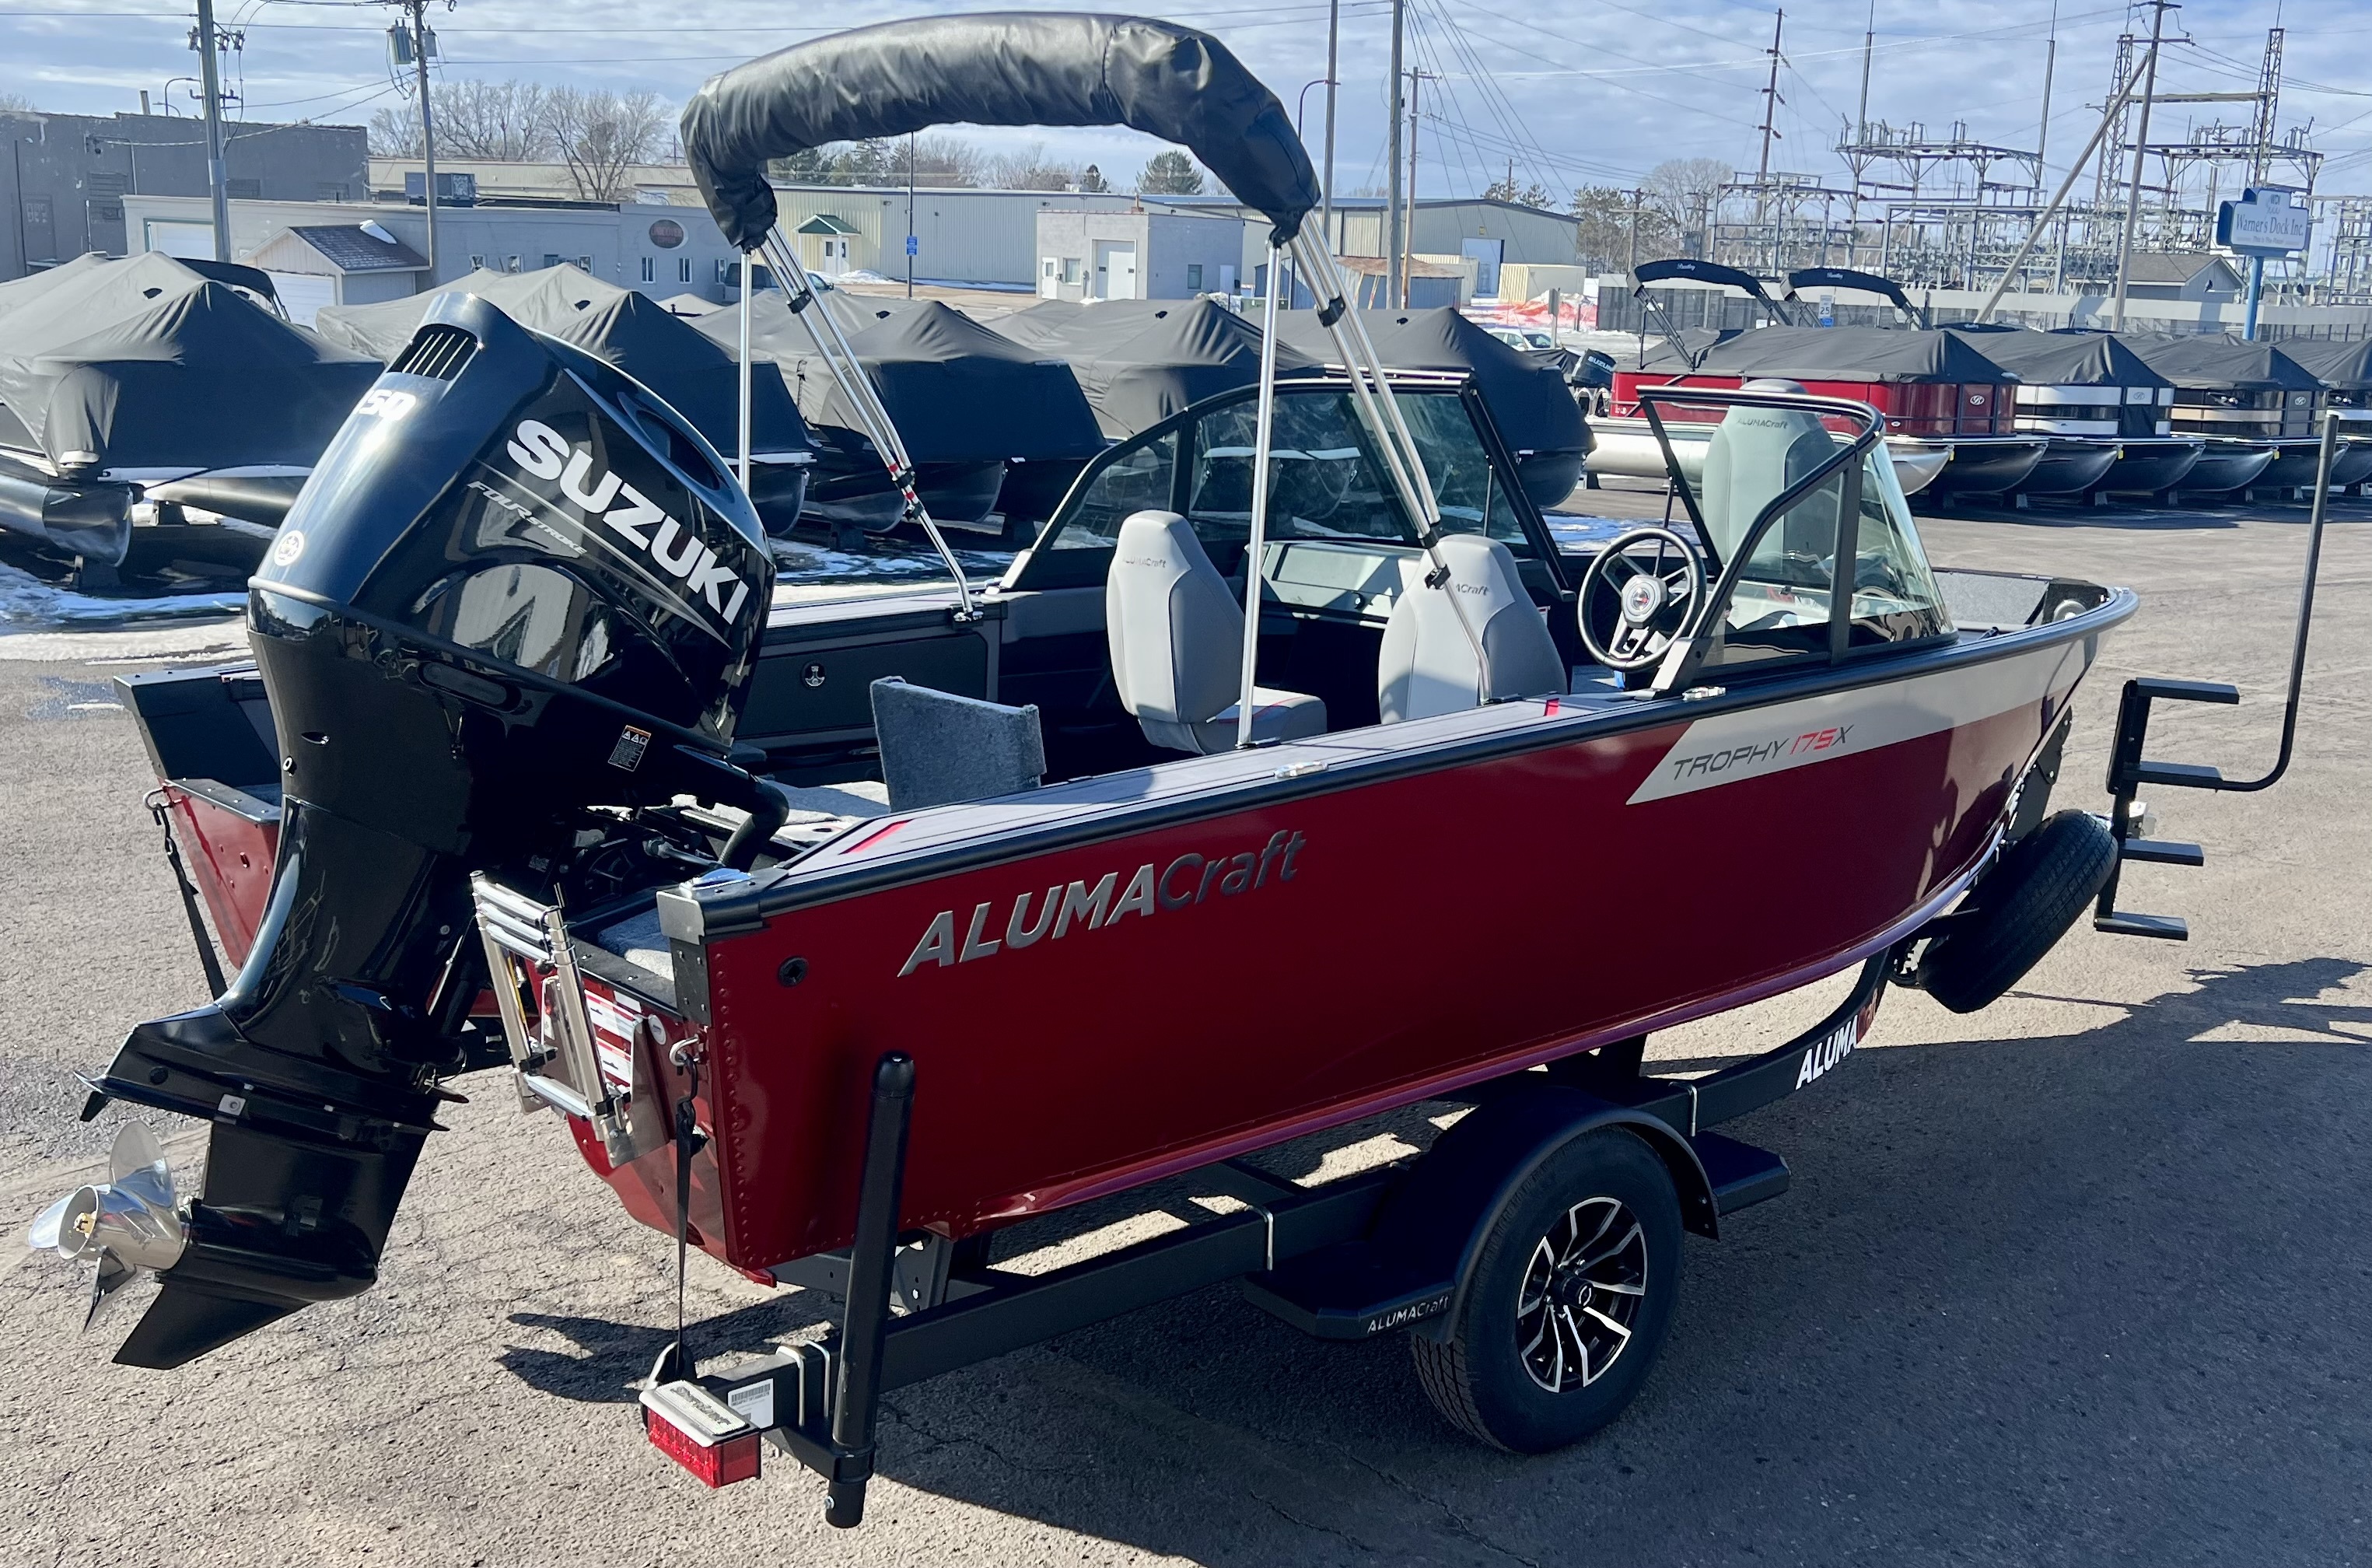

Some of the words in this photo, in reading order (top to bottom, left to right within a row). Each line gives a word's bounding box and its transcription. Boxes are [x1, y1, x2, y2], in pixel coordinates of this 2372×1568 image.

[2269, 216, 2290, 235] Dock
[2290, 219, 2304, 236] Inc.
[1820, 306, 1830, 315] 25
[507, 419, 749, 625] SUZUKI
[1674, 737, 1789, 780] TROPHY
[897, 829, 1307, 977] ALUMACraft
[1367, 1295, 1449, 1334] ALUMACraft
